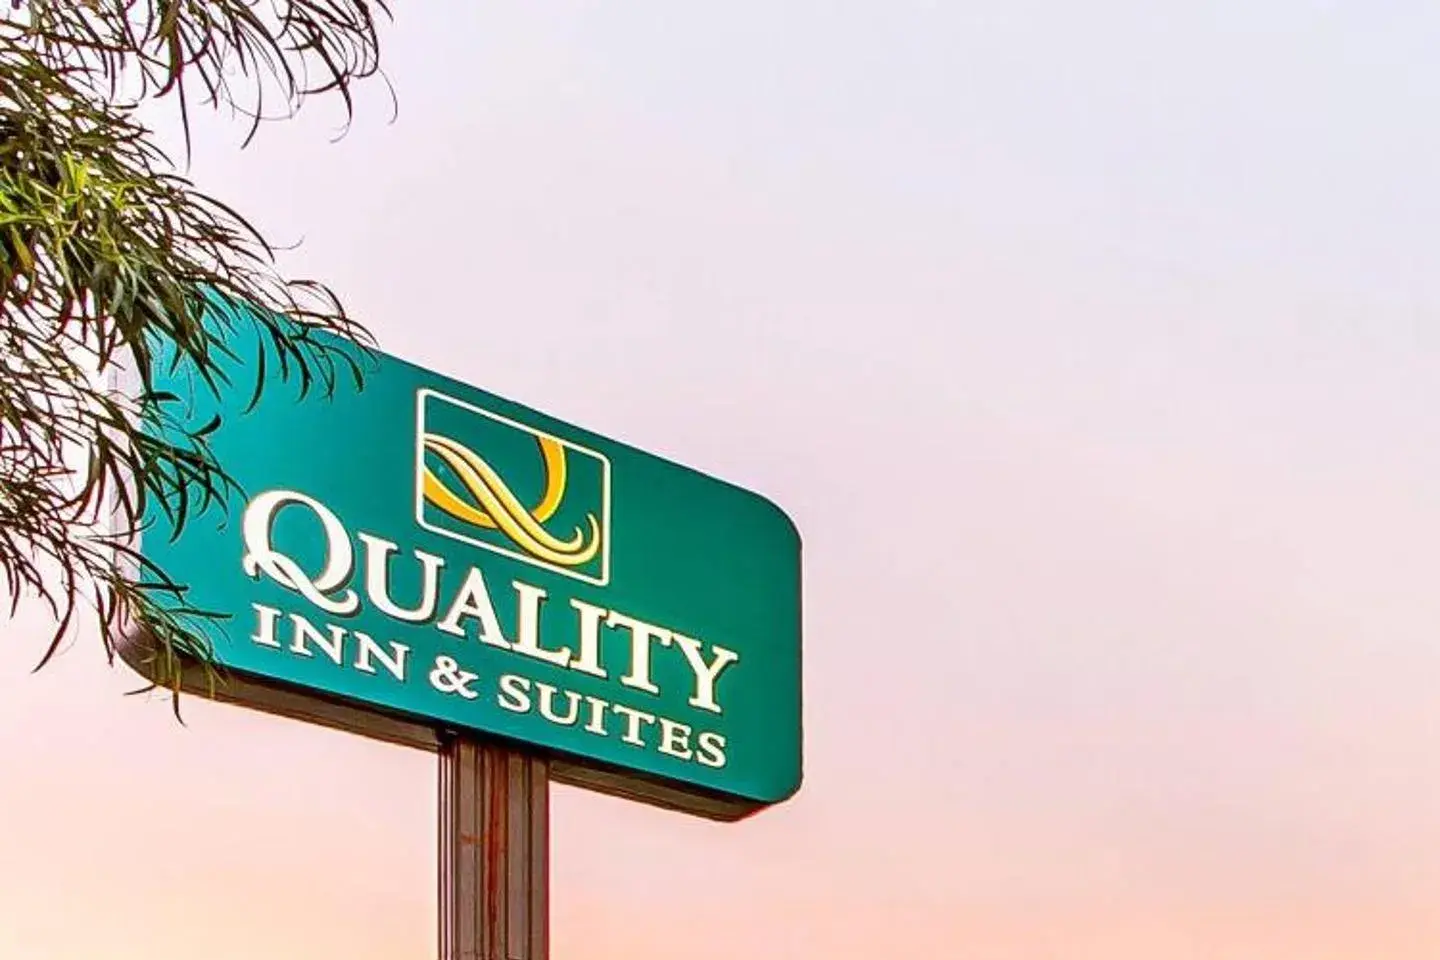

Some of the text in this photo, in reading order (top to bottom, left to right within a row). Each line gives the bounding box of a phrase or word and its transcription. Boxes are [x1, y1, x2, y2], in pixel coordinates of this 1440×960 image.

[244, 491, 738, 713] QUALITY
[252, 604, 728, 767] INN & SUITES
